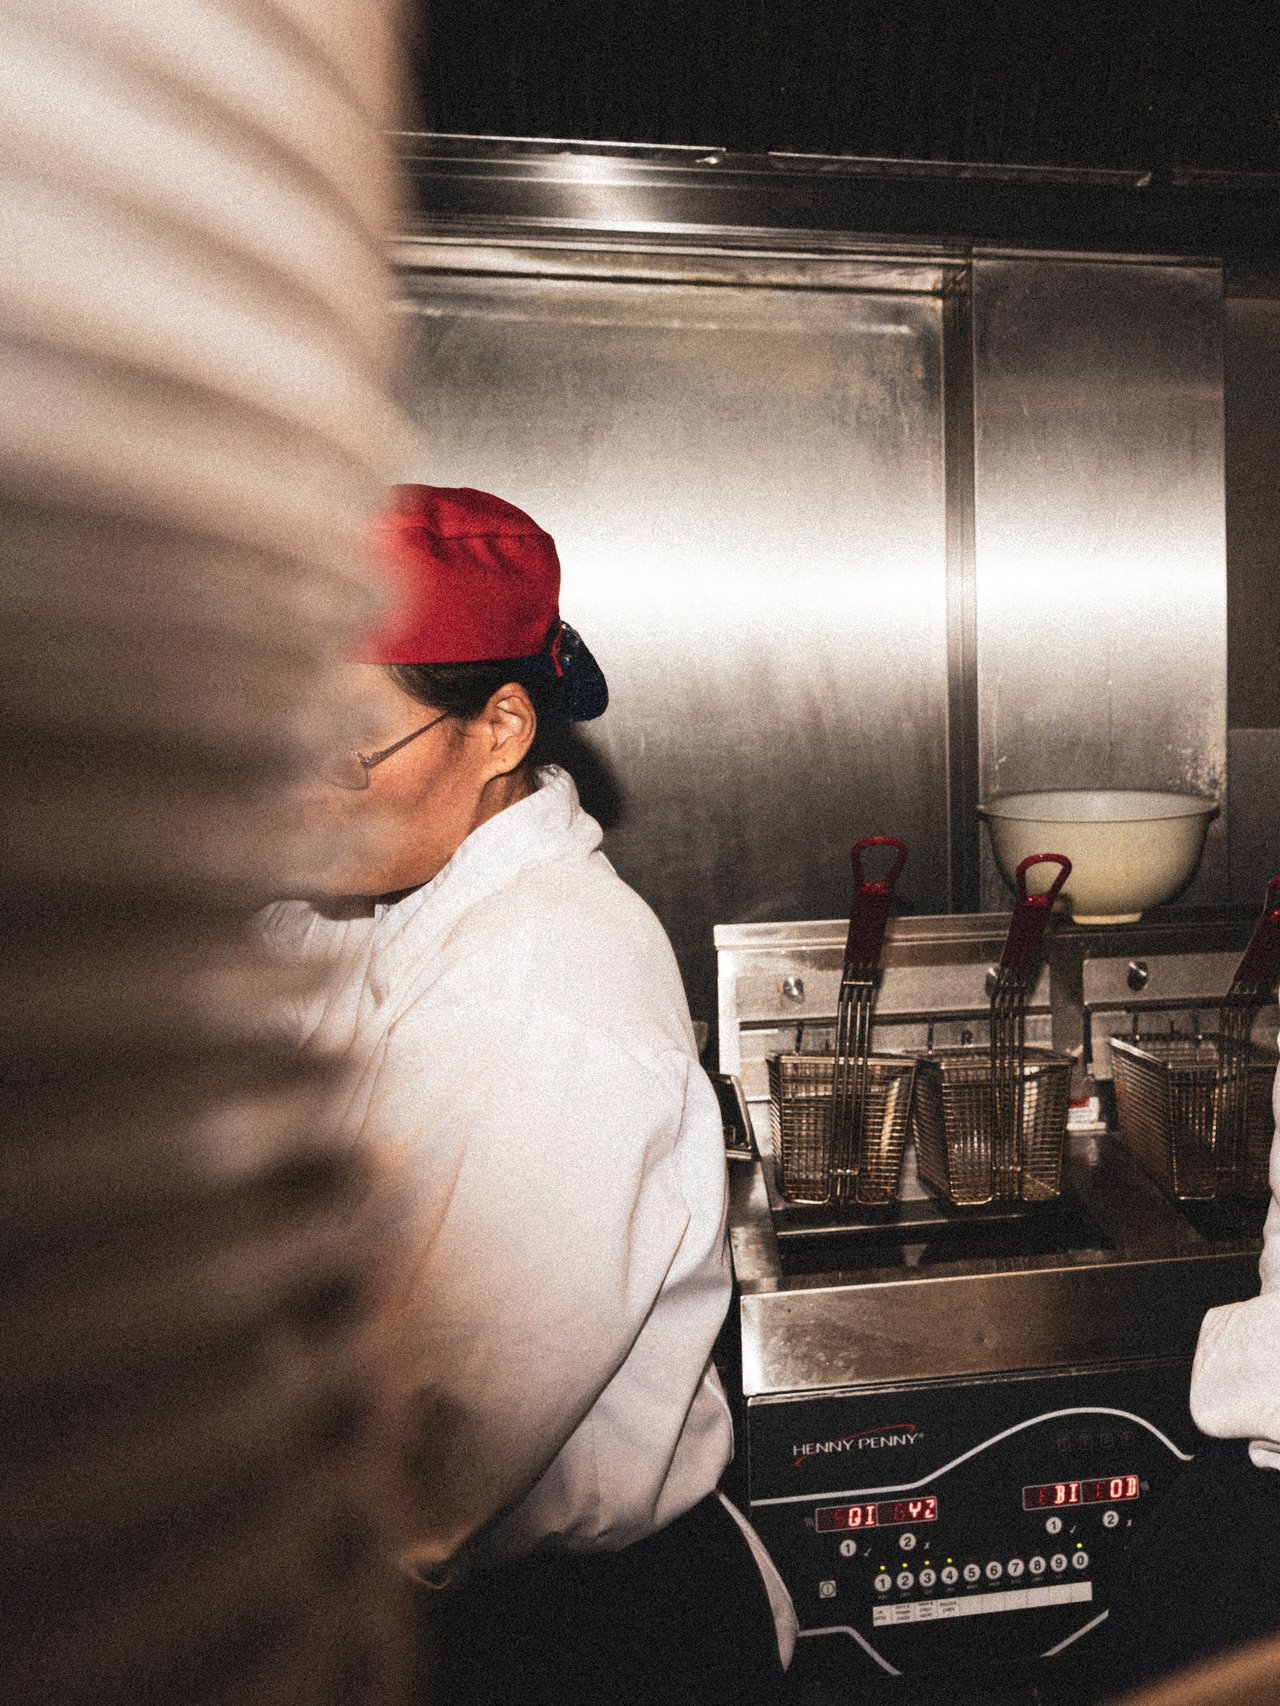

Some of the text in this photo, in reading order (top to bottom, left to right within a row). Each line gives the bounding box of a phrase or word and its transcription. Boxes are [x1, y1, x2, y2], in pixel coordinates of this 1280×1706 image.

[961, 1030, 973, 1045] R
[793, 1433, 917, 1456] HENNY PENNY
